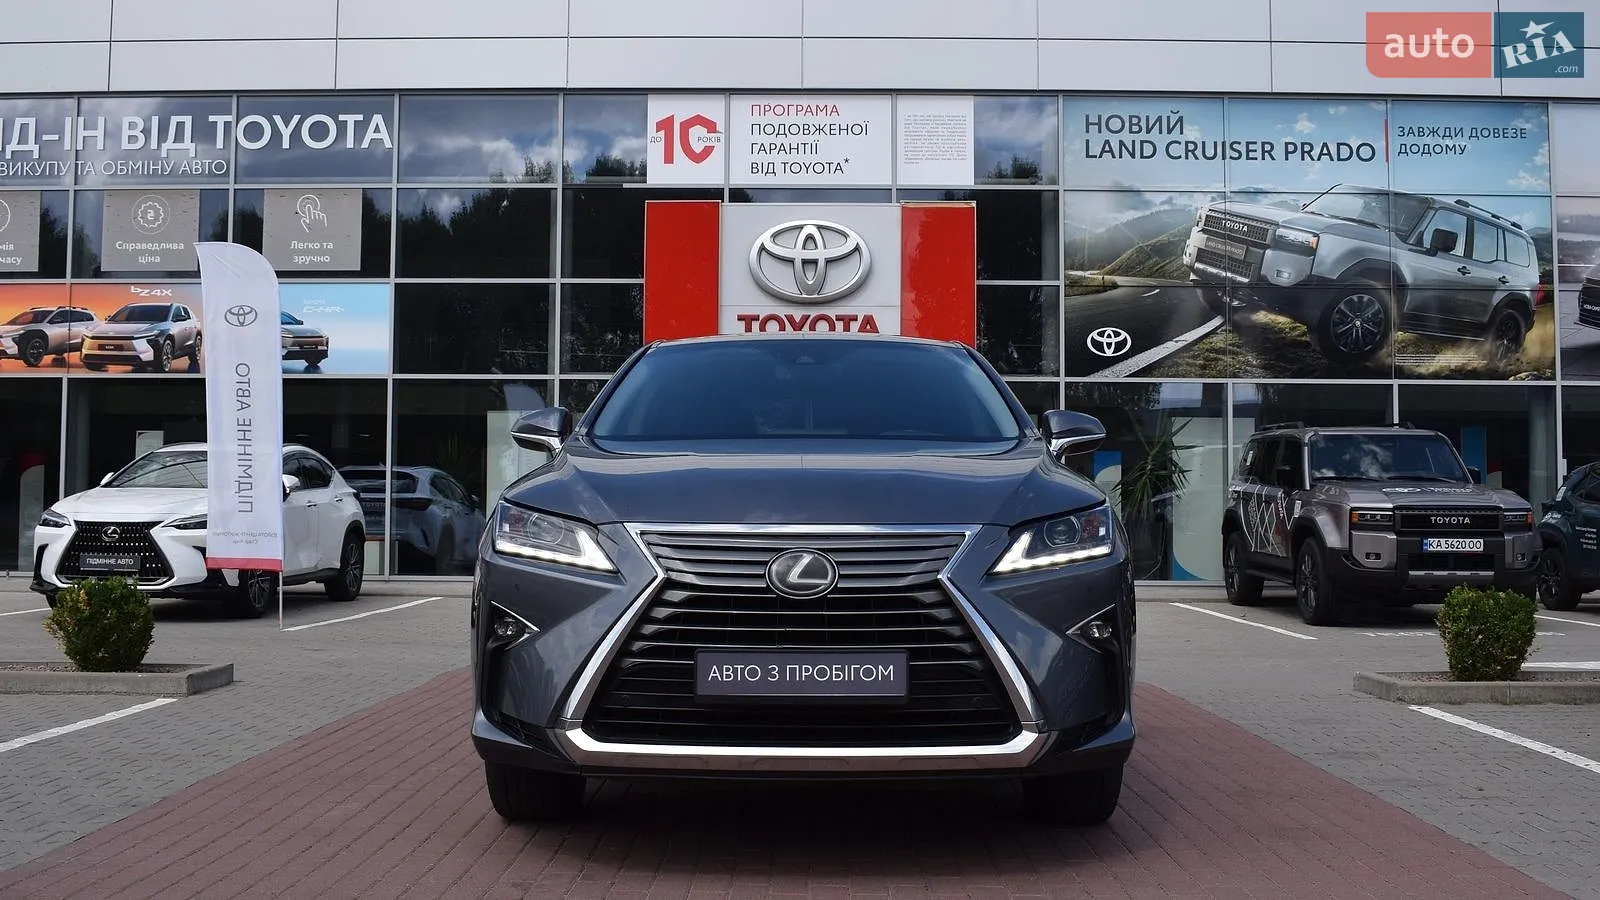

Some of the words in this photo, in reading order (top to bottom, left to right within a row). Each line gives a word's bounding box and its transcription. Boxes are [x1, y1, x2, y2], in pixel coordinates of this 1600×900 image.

[751, 104, 840, 117] ПРОГРАМА
[751, 120, 870, 138] ПОДОВЖЕНОЇ
[1085, 110, 1185, 135] НОВИЙ
[120, 115, 196, 158] ВІД
[208, 113, 393, 150] TOYOTA
[649, 135, 662, 144] ДО
[1397, 126, 1464, 139] ЗАВЖДИ
[1468, 127, 1528, 141] ДОВЕЗЕ
[750, 139, 820, 155] ГАРАНТІЇ
[1085, 139, 1157, 160] LAND
[1165, 140, 1276, 161] CRUISER
[1284, 141, 1377, 162] PRADO
[1397, 143, 1468, 157] ДОДОМУ
[76, 160, 96, 175] ТА
[101, 160, 174, 176] ОБМІНУ
[178, 159, 227, 175] АВТО
[750, 161, 776, 176] ВІД
[115, 240, 185, 252] Справедлива
[290, 240, 320, 250] Легко
[323, 241, 334, 250] та
[138, 254, 161, 265] ціна
[292, 253, 331, 264] зручно
[1430, 516, 1471, 524] TOYOTA
[1428, 539, 1443, 550] KA
[1444, 539, 1467, 550] 5620
[708, 664, 761, 682] АВТО
[786, 664, 895, 682] ПРОБІГОМ
